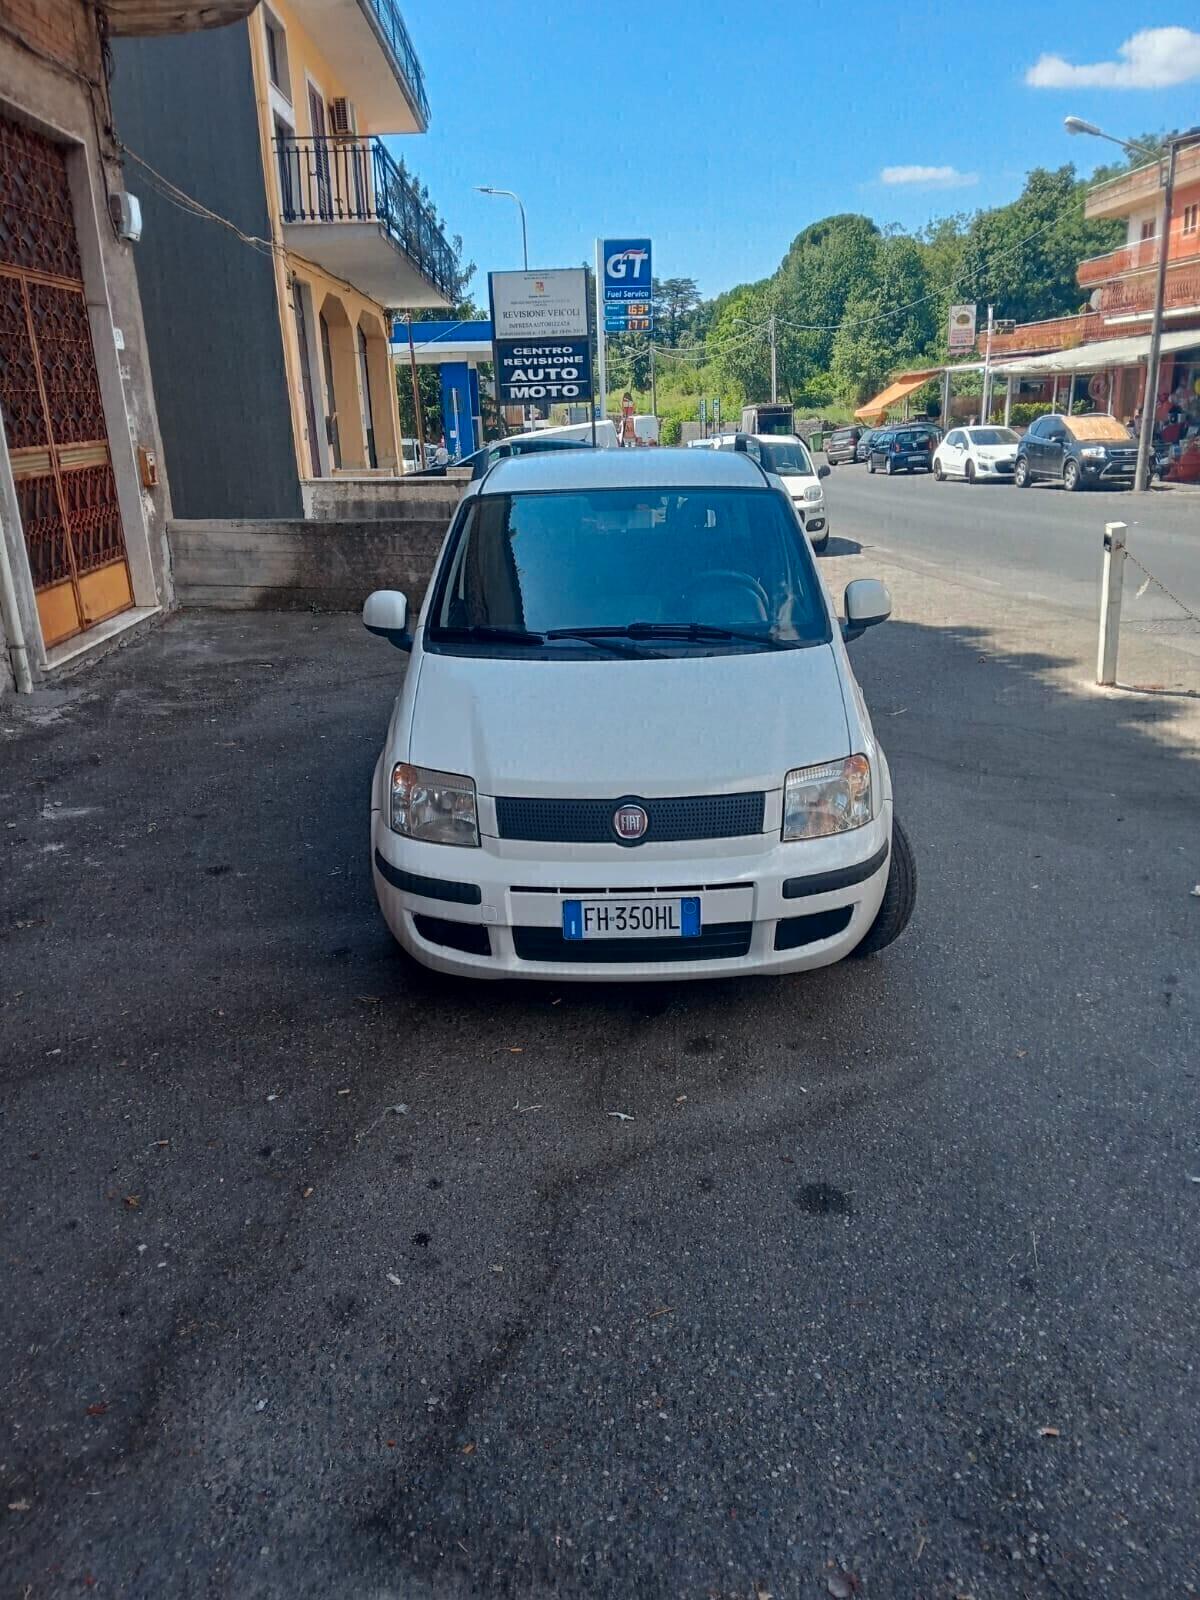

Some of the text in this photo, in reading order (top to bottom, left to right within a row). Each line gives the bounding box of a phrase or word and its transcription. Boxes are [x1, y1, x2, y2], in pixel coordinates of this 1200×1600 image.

[606, 251, 649, 279] GT
[607, 290, 649, 298] Fuel Service
[503, 308, 580, 319] REVISIONE VEICOLI
[513, 347, 573, 355] CENTRO
[503, 355, 584, 366] REVISIONE
[510, 368, 578, 381] AUTO
[510, 385, 579, 399] MOTO
[621, 814, 641, 831] FIAT
